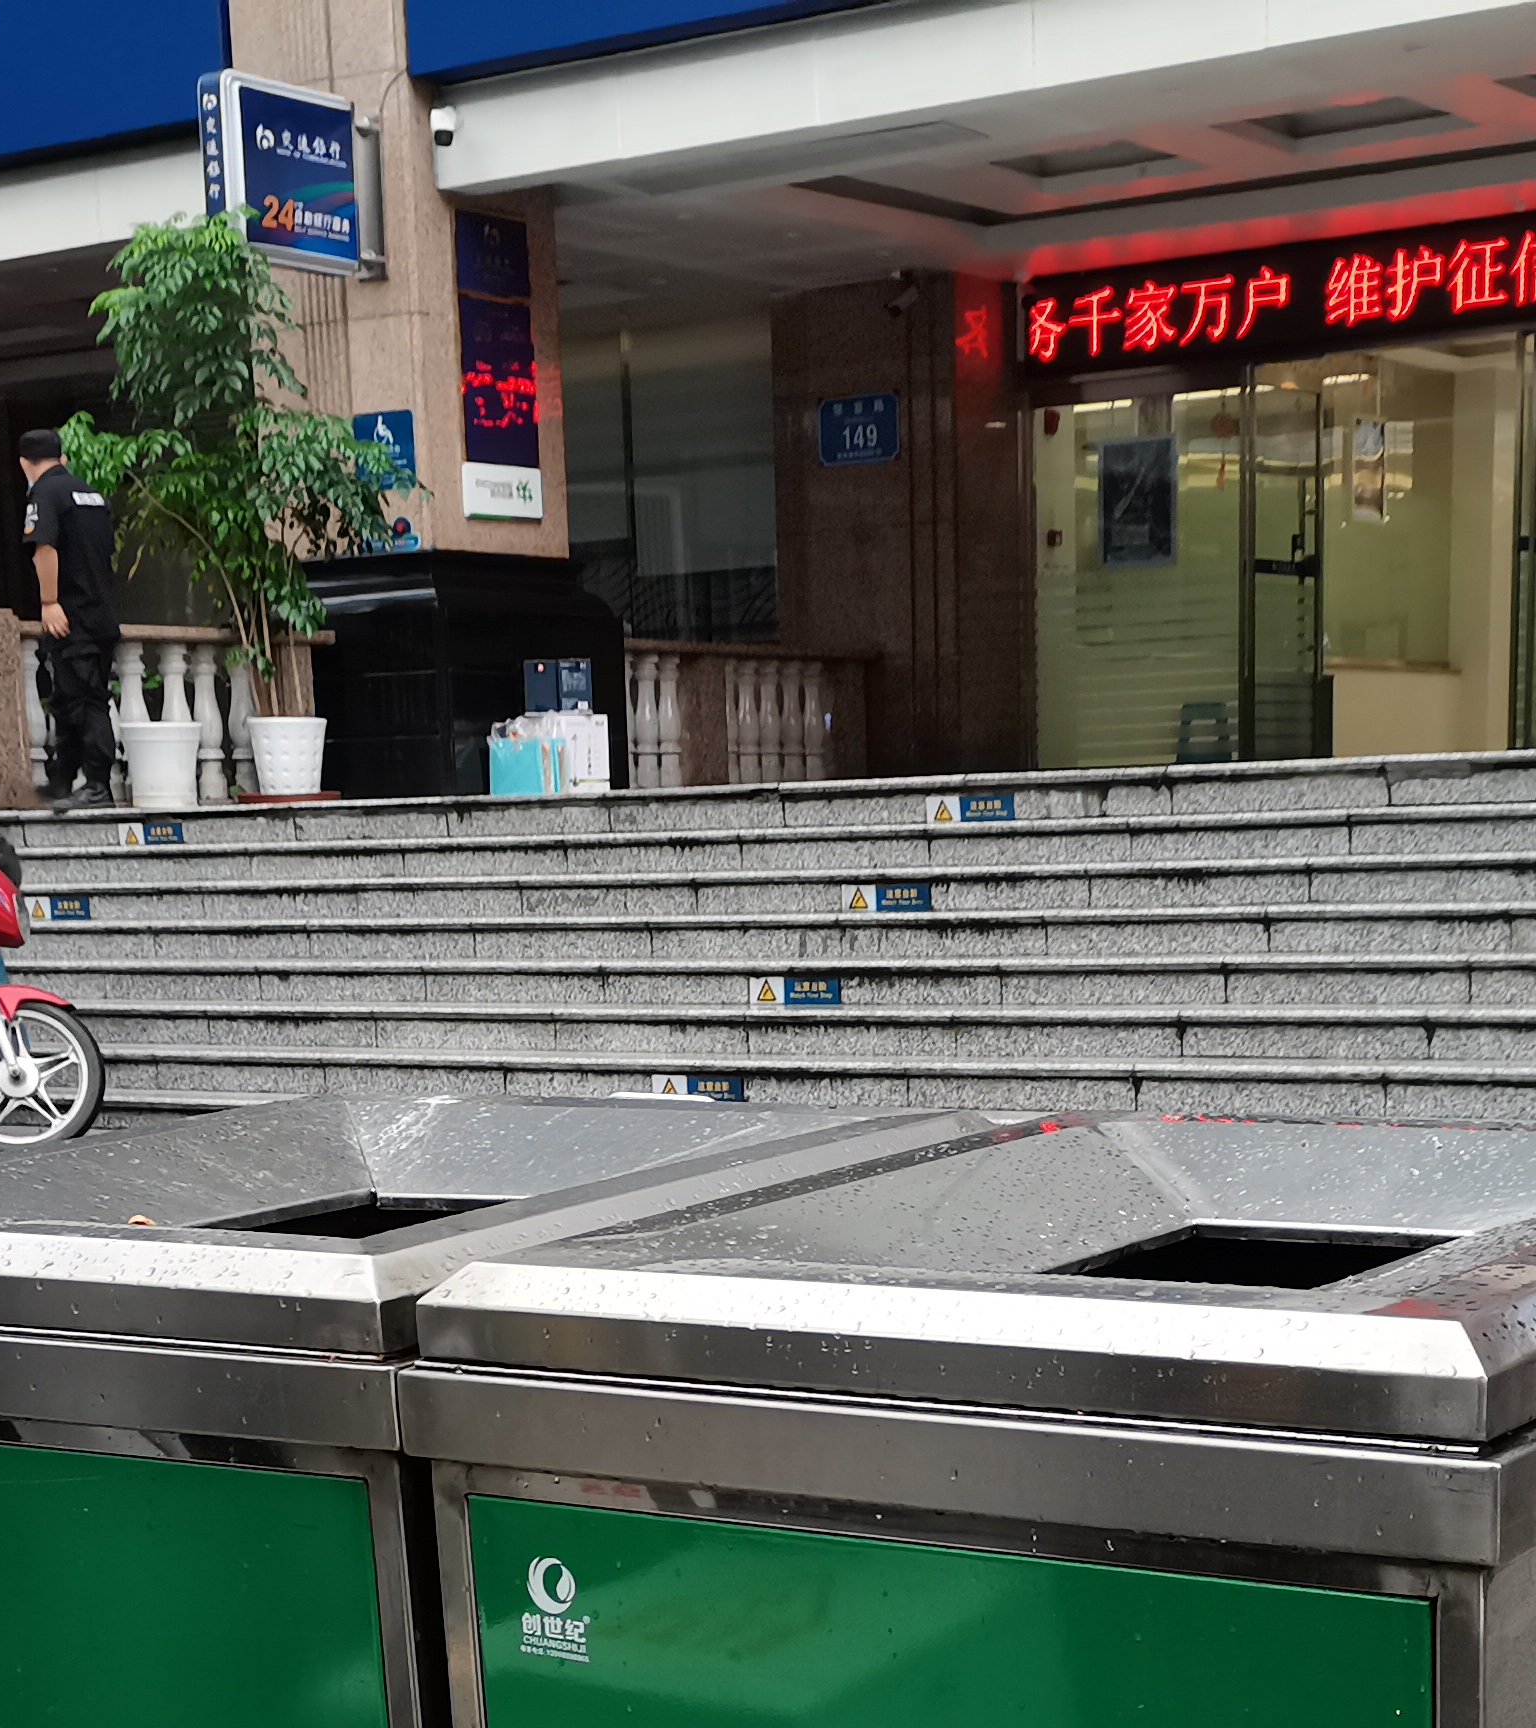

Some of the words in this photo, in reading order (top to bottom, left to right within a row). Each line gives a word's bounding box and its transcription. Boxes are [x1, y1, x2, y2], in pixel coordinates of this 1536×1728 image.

[842, 424, 878, 450] 149
[521, 1612, 587, 1643] 创世纪
